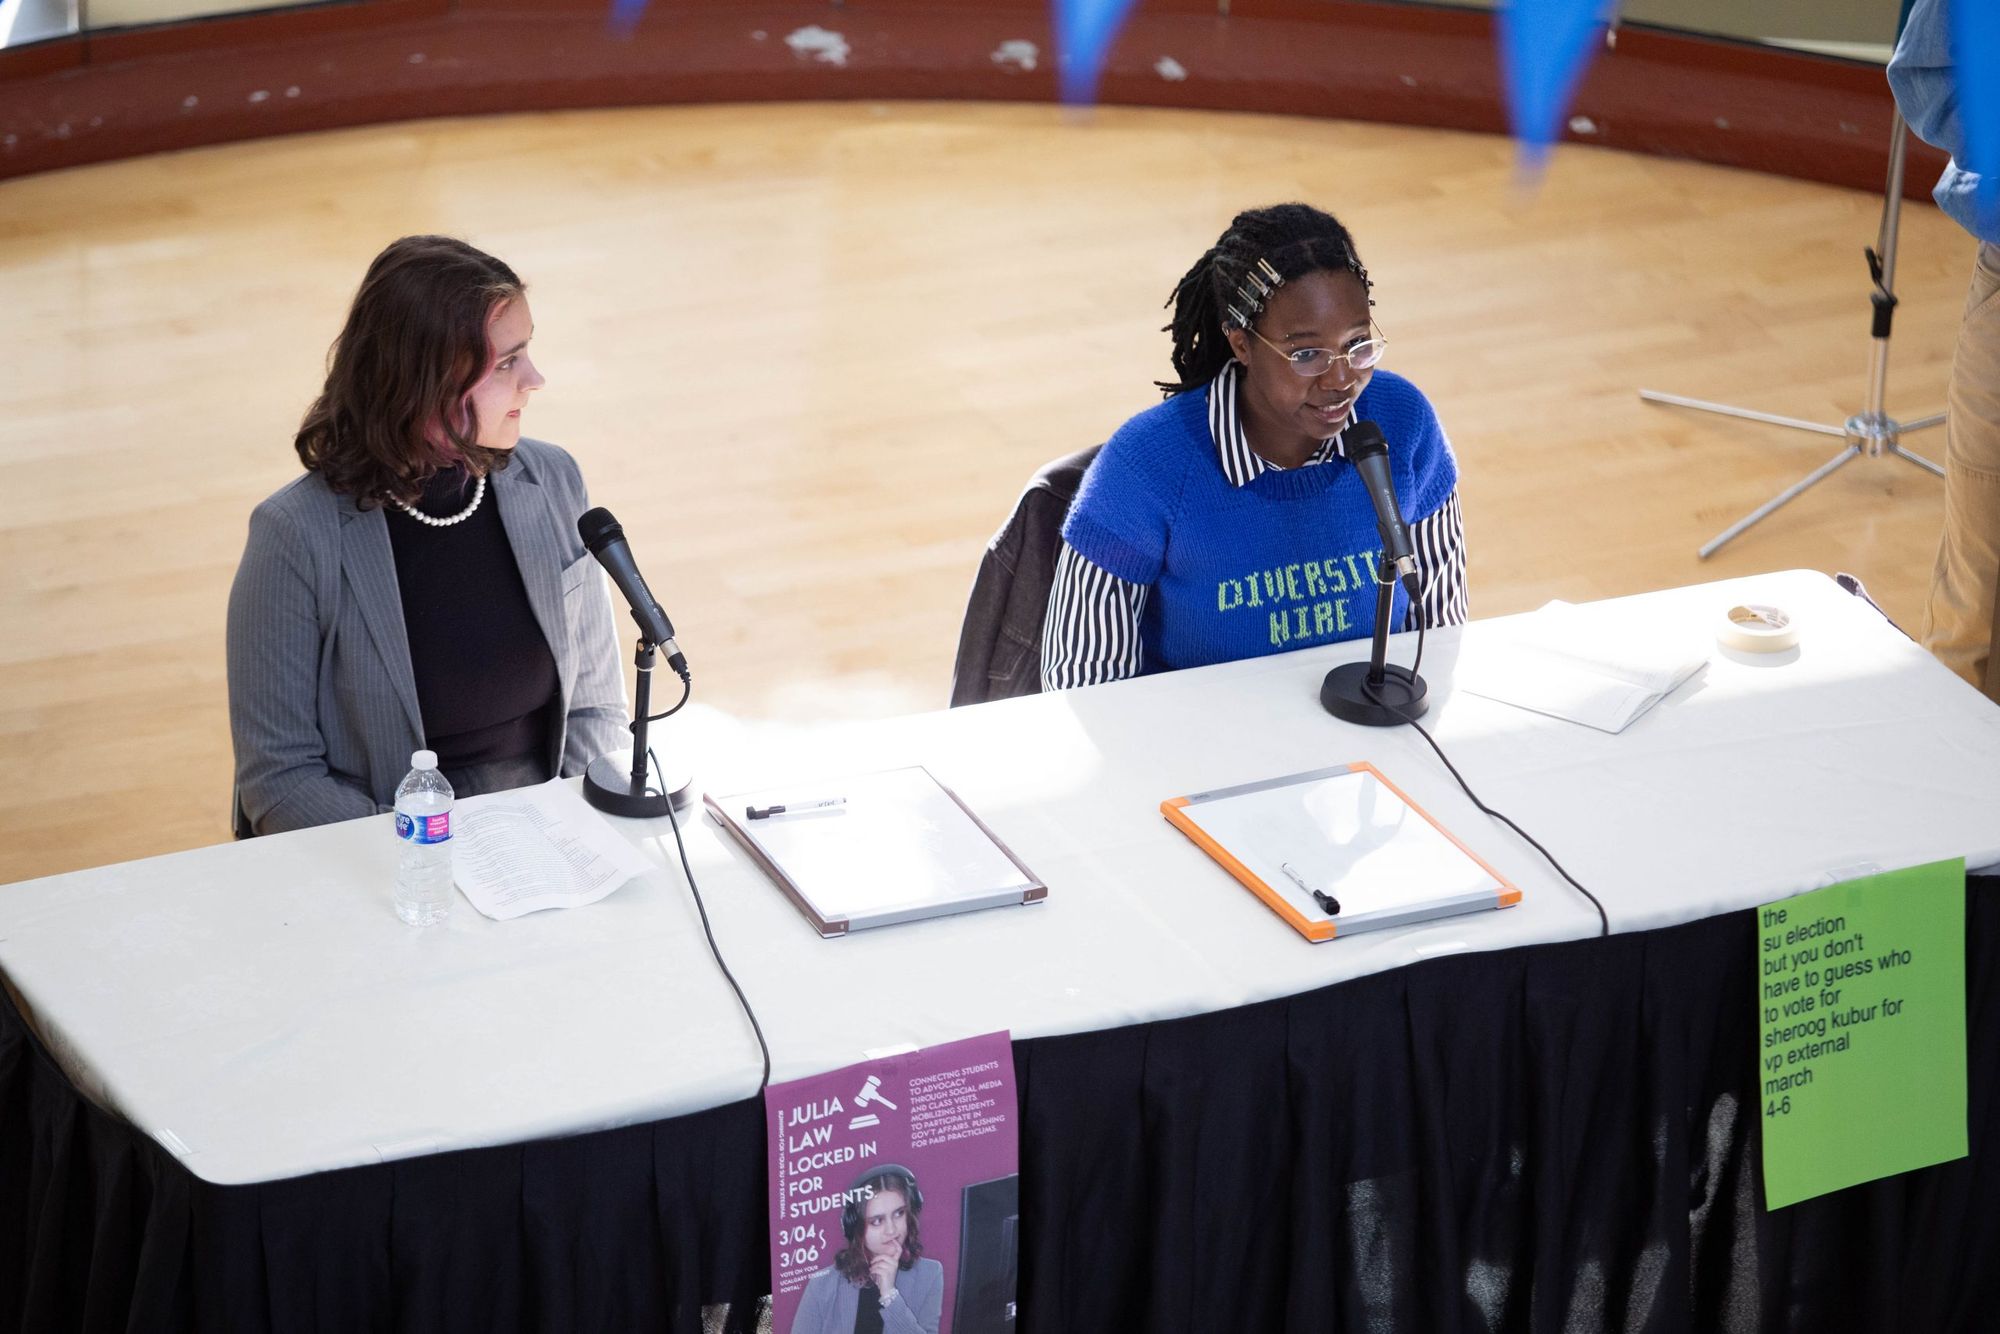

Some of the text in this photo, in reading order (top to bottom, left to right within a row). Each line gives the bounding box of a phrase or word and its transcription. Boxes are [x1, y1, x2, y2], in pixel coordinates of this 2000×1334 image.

[1218, 549, 1384, 612] DIVERSIT
[1269, 598, 1351, 646] HIRE
[1763, 909, 1787, 928] the
[1764, 916, 1846, 952] su election
[1764, 933, 1864, 976] but you don't
[1764, 949, 1911, 1000] have to guess who
[1765, 989, 1841, 1024] to vote for
[1765, 998, 1904, 1048] sheroog kubur for
[1765, 1032, 1850, 1073] vp external
[909, 1060, 999, 1087] CONNECTING STUDENTS
[910, 1078, 966, 1096] TO ADVOCACY
[1766, 1067, 1813, 1096] march
[910, 1079, 1003, 1105] THROUGH SOCIAL MEDIA
[788, 1096, 844, 1127] JULIA
[910, 1104, 927, 1114] AND
[928, 1098, 953, 1110] CLASS
[910, 1099, 995, 1123] MOBILIZING STUDENTS
[1766, 1095, 1791, 1118] 4-6
[911, 1111, 982, 1132] TO PARTICIPATE IN
[911, 1128, 935, 1140] GOV'T
[972, 1114, 1005, 1127] PUSHING
[789, 1124, 833, 1154] LAW
[911, 1139, 927, 1149] FOR
[929, 1135, 946, 1145] PAID
[789, 1140, 877, 1176] LOCKED IN
[789, 1176, 823, 1197] FOR
[790, 1184, 878, 1218] STUDENTS.
[779, 1223, 816, 1245] 3/04
[780, 1245, 819, 1267] 3/06
[780, 1270, 794, 1278] VOTE
